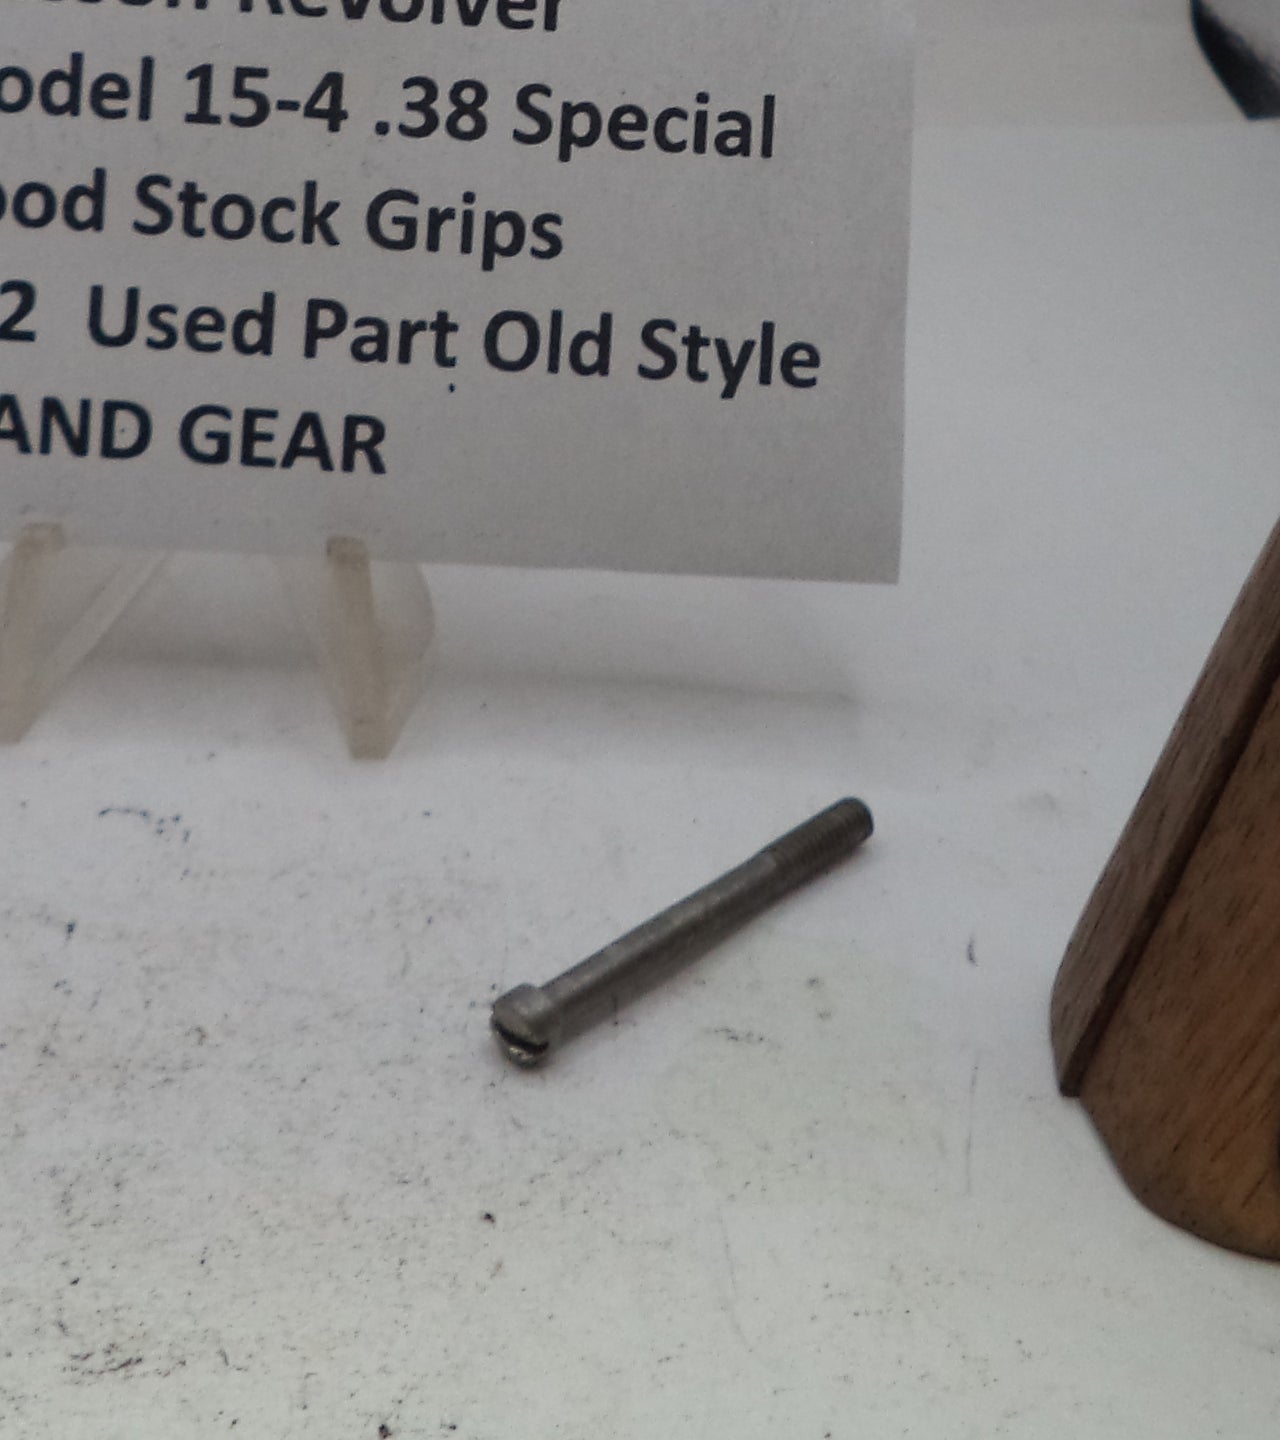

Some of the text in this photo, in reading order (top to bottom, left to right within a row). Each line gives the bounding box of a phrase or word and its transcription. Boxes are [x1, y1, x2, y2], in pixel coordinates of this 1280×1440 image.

[183, 62, 350, 135] 15-4
[373, 74, 490, 143] .38
[511, 81, 777, 164] Special
[131, 173, 342, 248] Stock
[364, 187, 564, 274] Grips
[86, 283, 278, 358] Used
[302, 296, 461, 370] Part
[482, 308, 614, 378] Old
[636, 317, 822, 401] Style
[177, 403, 388, 476] GEAR
